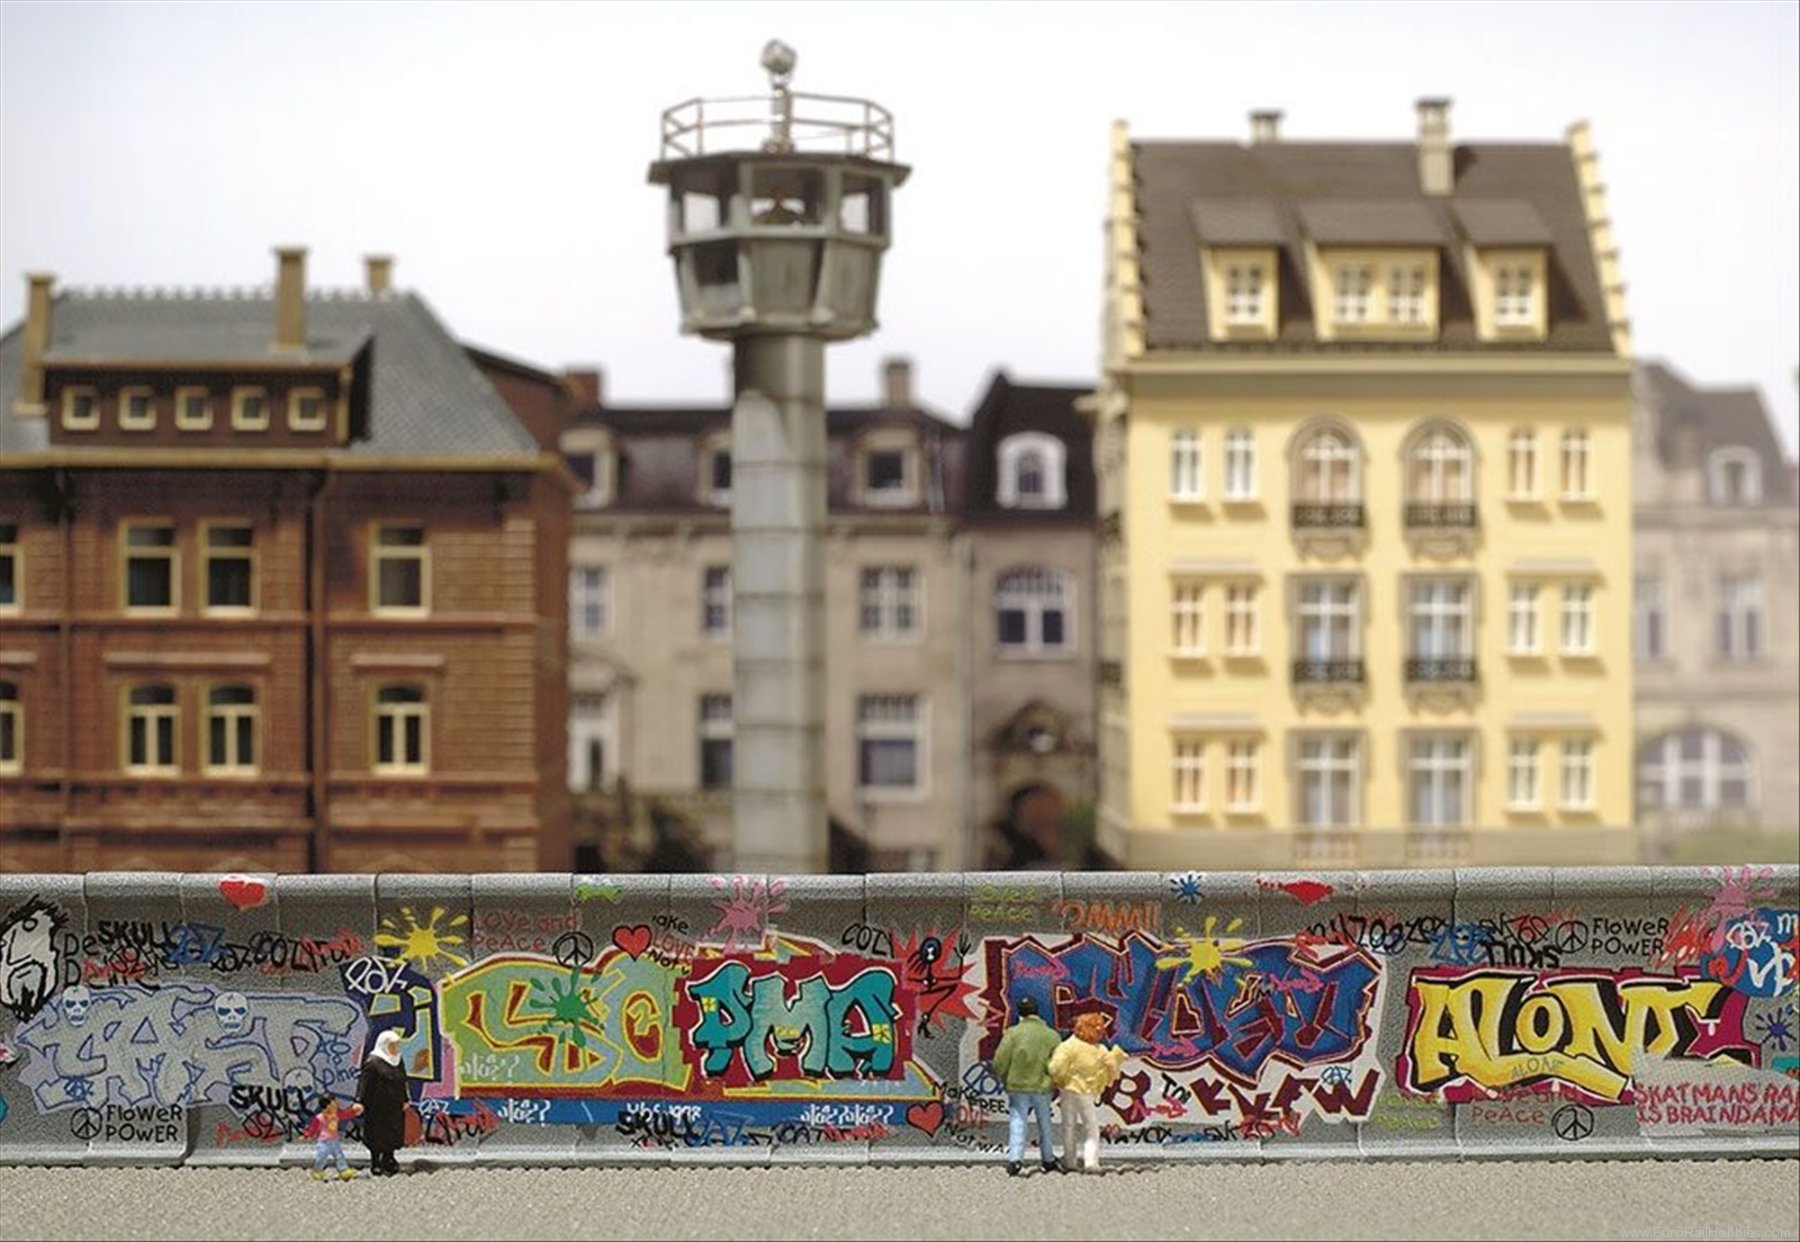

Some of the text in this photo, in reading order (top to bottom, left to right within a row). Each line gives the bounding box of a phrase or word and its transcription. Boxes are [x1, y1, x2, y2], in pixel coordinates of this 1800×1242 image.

[652, 914, 689, 936] aKe
[1591, 937, 1664, 957] POWER
[106, 1123, 178, 1143] POWER
